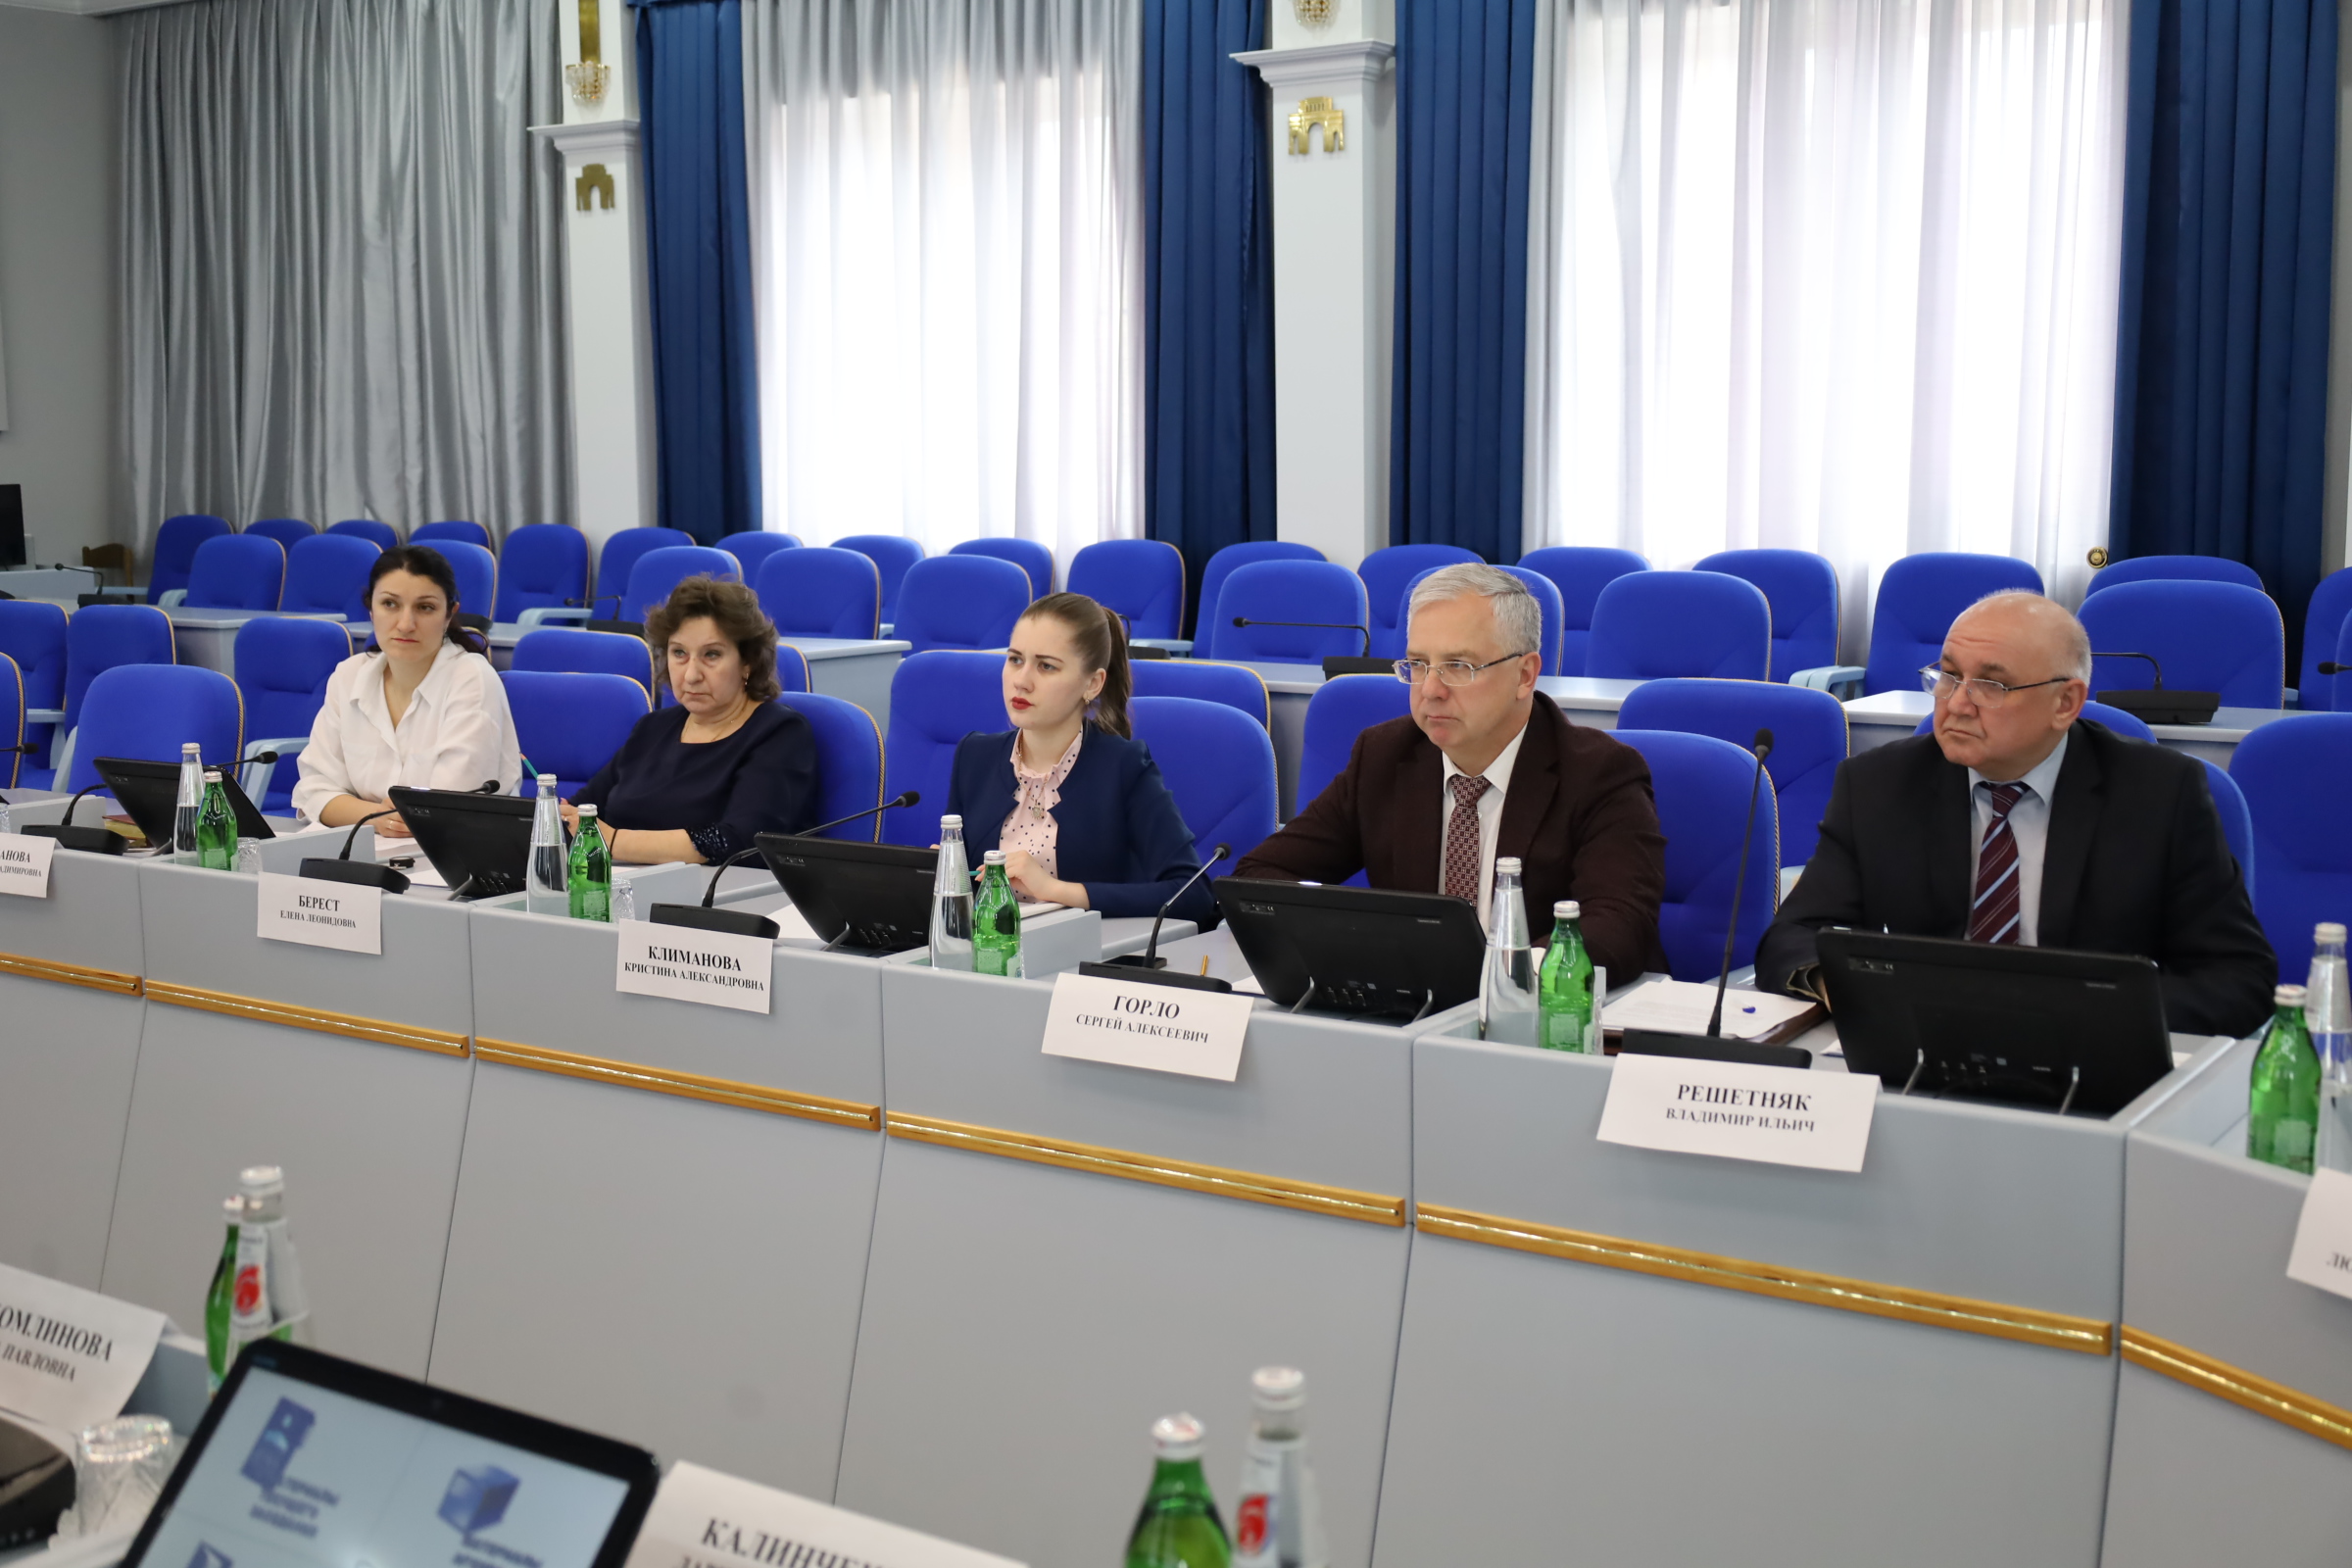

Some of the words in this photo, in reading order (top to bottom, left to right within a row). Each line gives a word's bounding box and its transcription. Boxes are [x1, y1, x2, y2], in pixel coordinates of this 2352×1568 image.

[298, 895, 340, 912] БЕРЕСТ
[279, 909, 305, 921] ЕЛЕНА
[306, 913, 357, 928] ЛЕОНИДОВНА
[648, 945, 742, 972] КЛИМАНОВА
[624, 961, 677, 978] КРИСТИНА
[679, 970, 764, 992] АЛЕКСАНДРОВНА
[1112, 995, 1181, 1019] ГОРЛО
[1076, 1013, 1122, 1031] СЕРГЕЙ
[1124, 1021, 1209, 1044] АЛЕКСЕЕВИЧ
[1677, 1084, 1812, 1111] РЕШЕТНЯК
[1666, 1107, 1754, 1126] ВЛАДИМИР
[1758, 1116, 1815, 1132] ИЛЬИЧ
[2, 1343, 76, 1383] ПАВЛОВНА
